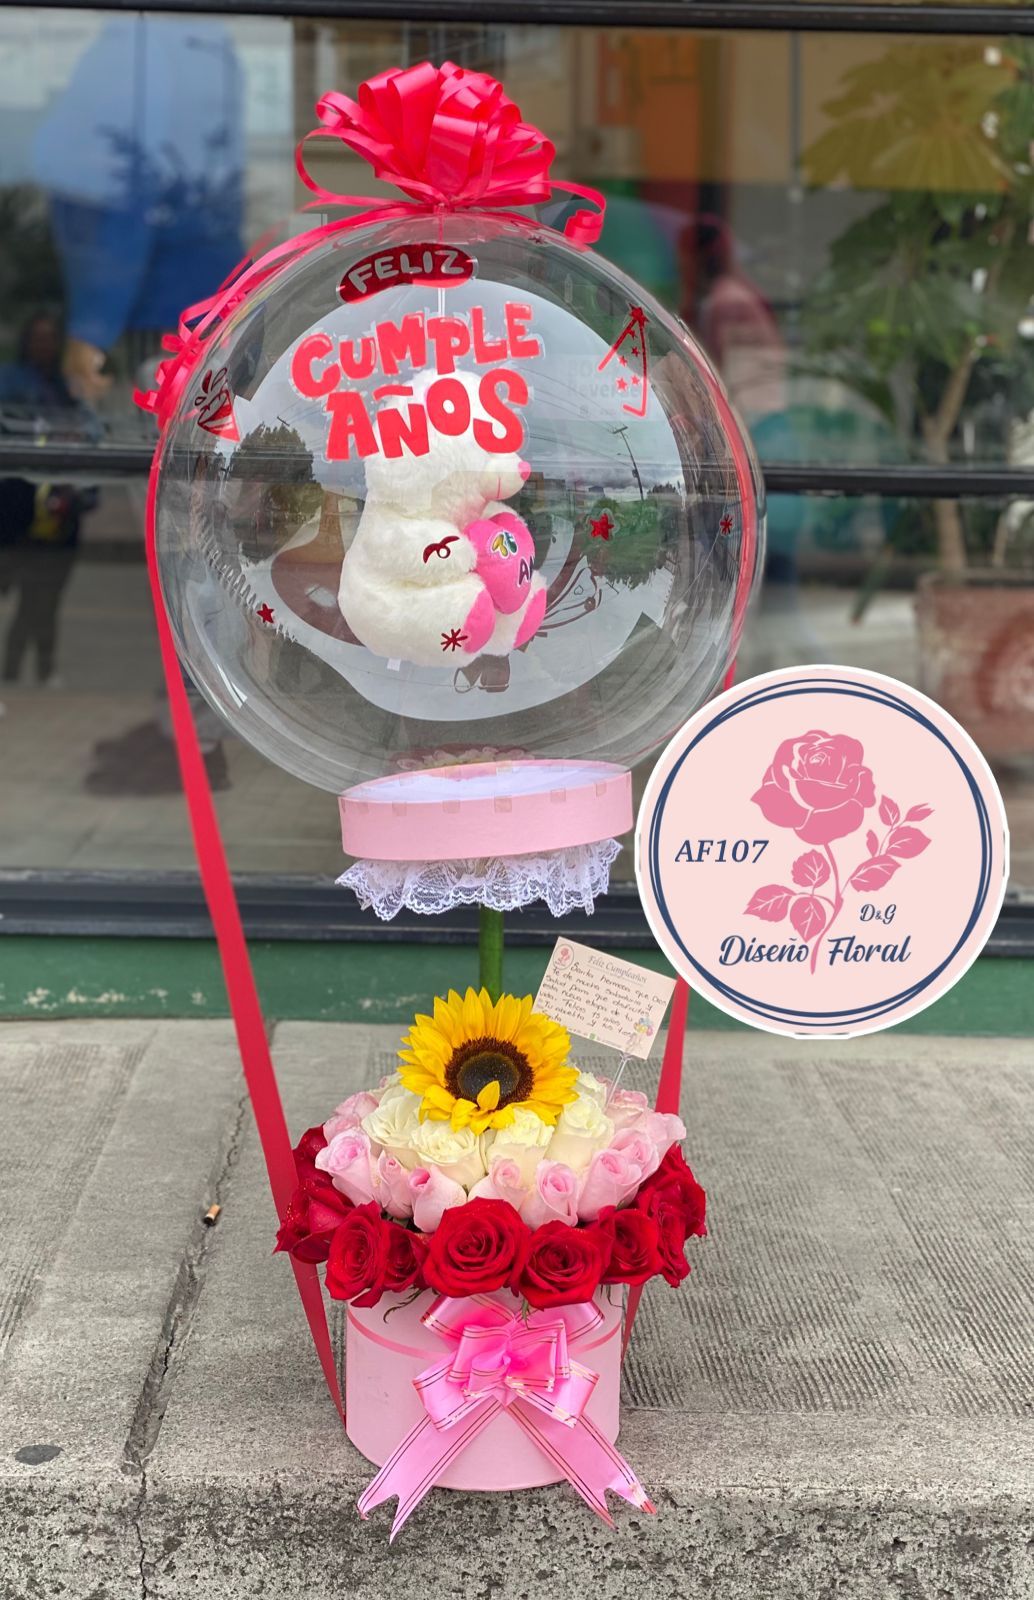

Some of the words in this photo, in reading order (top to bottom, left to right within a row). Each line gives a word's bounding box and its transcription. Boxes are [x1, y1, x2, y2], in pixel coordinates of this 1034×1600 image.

[347, 249, 465, 294] FELIZ
[290, 301, 541, 399] CUMPLE
[325, 367, 529, 461] AÑOS
[588, 955, 605, 968] Feliz
